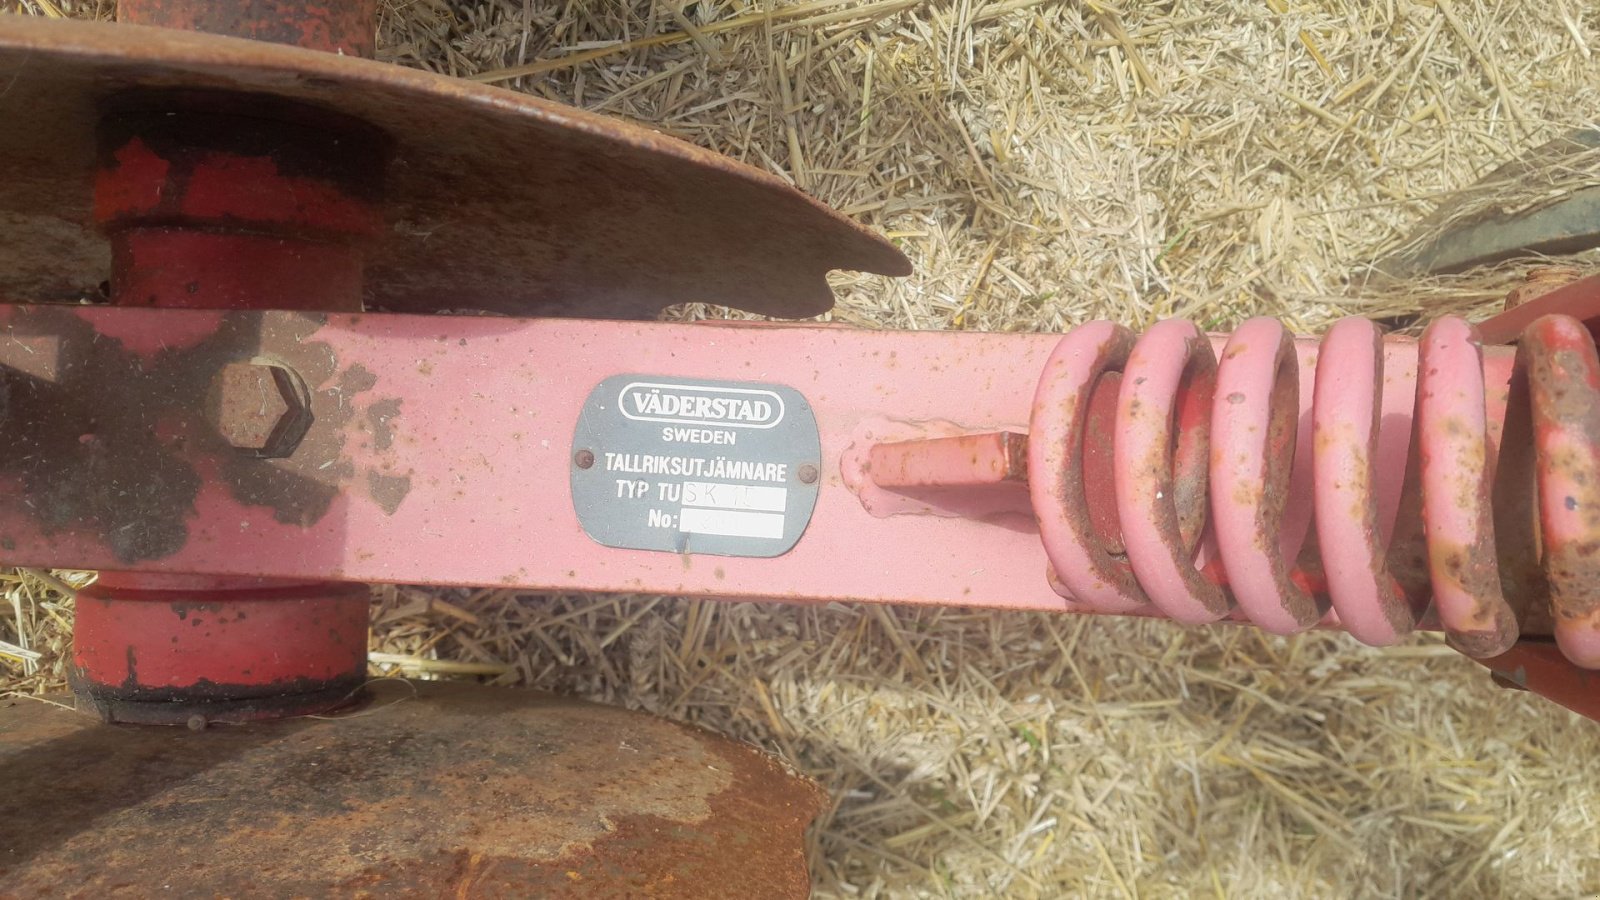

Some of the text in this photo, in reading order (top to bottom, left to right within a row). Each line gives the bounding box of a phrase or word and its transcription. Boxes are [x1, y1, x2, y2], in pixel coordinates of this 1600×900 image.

[632, 389, 772, 422] VÄDERSTAD
[662, 426, 737, 445] SWEDEN
[605, 452, 787, 482] TALLRIKSUTJÄMNARE
[616, 479, 650, 499] TYP
[647, 508, 679, 529] No:
